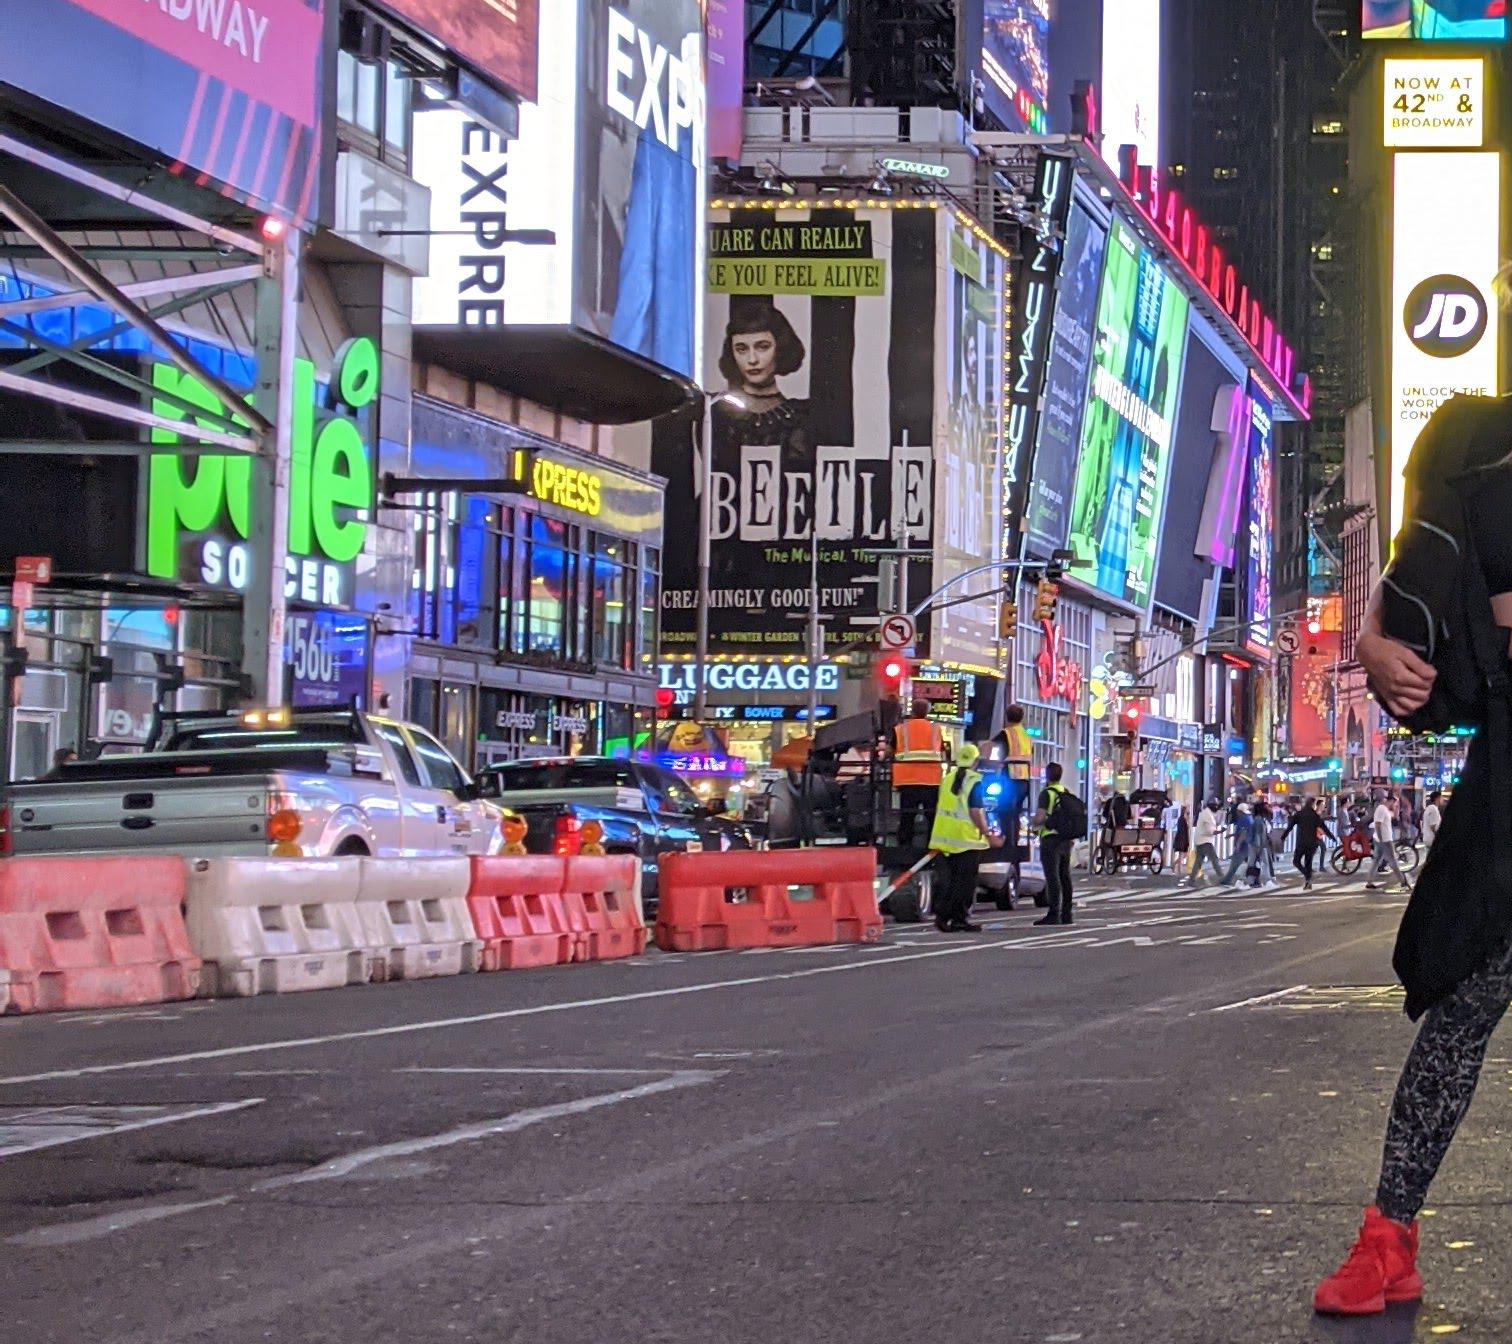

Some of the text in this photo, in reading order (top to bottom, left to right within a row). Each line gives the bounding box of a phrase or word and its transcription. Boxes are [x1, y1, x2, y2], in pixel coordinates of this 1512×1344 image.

[1393, 77, 1473, 90] NOW AT
[1456, 94, 1474, 114] &
[1391, 117, 1474, 129] BROADWAY
[887, 160, 945, 177] LAMAR
[709, 226, 866, 252] UARE CAN REALLY
[733, 265, 767, 287] YOU
[774, 264, 817, 288] FEEL
[824, 264, 880, 288] ALIVE!
[1196, 225, 1293, 389] BROADWAY
[1413, 293, 1479, 339] JD
[1402, 387, 1488, 397] UNLOCK THE
[1402, 399, 1441, 408] WORL
[709, 458, 924, 541] BEETLE
[764, 548, 788, 564] The
[791, 547, 847, 564] Muical.
[202, 540, 342, 606] SOCER
[662, 587, 765, 609] CREAMINGLY
[658, 663, 839, 691] LUGGAGE
[497, 711, 536, 730] EXPRESS
[553, 715, 587, 734] EXPRESS
